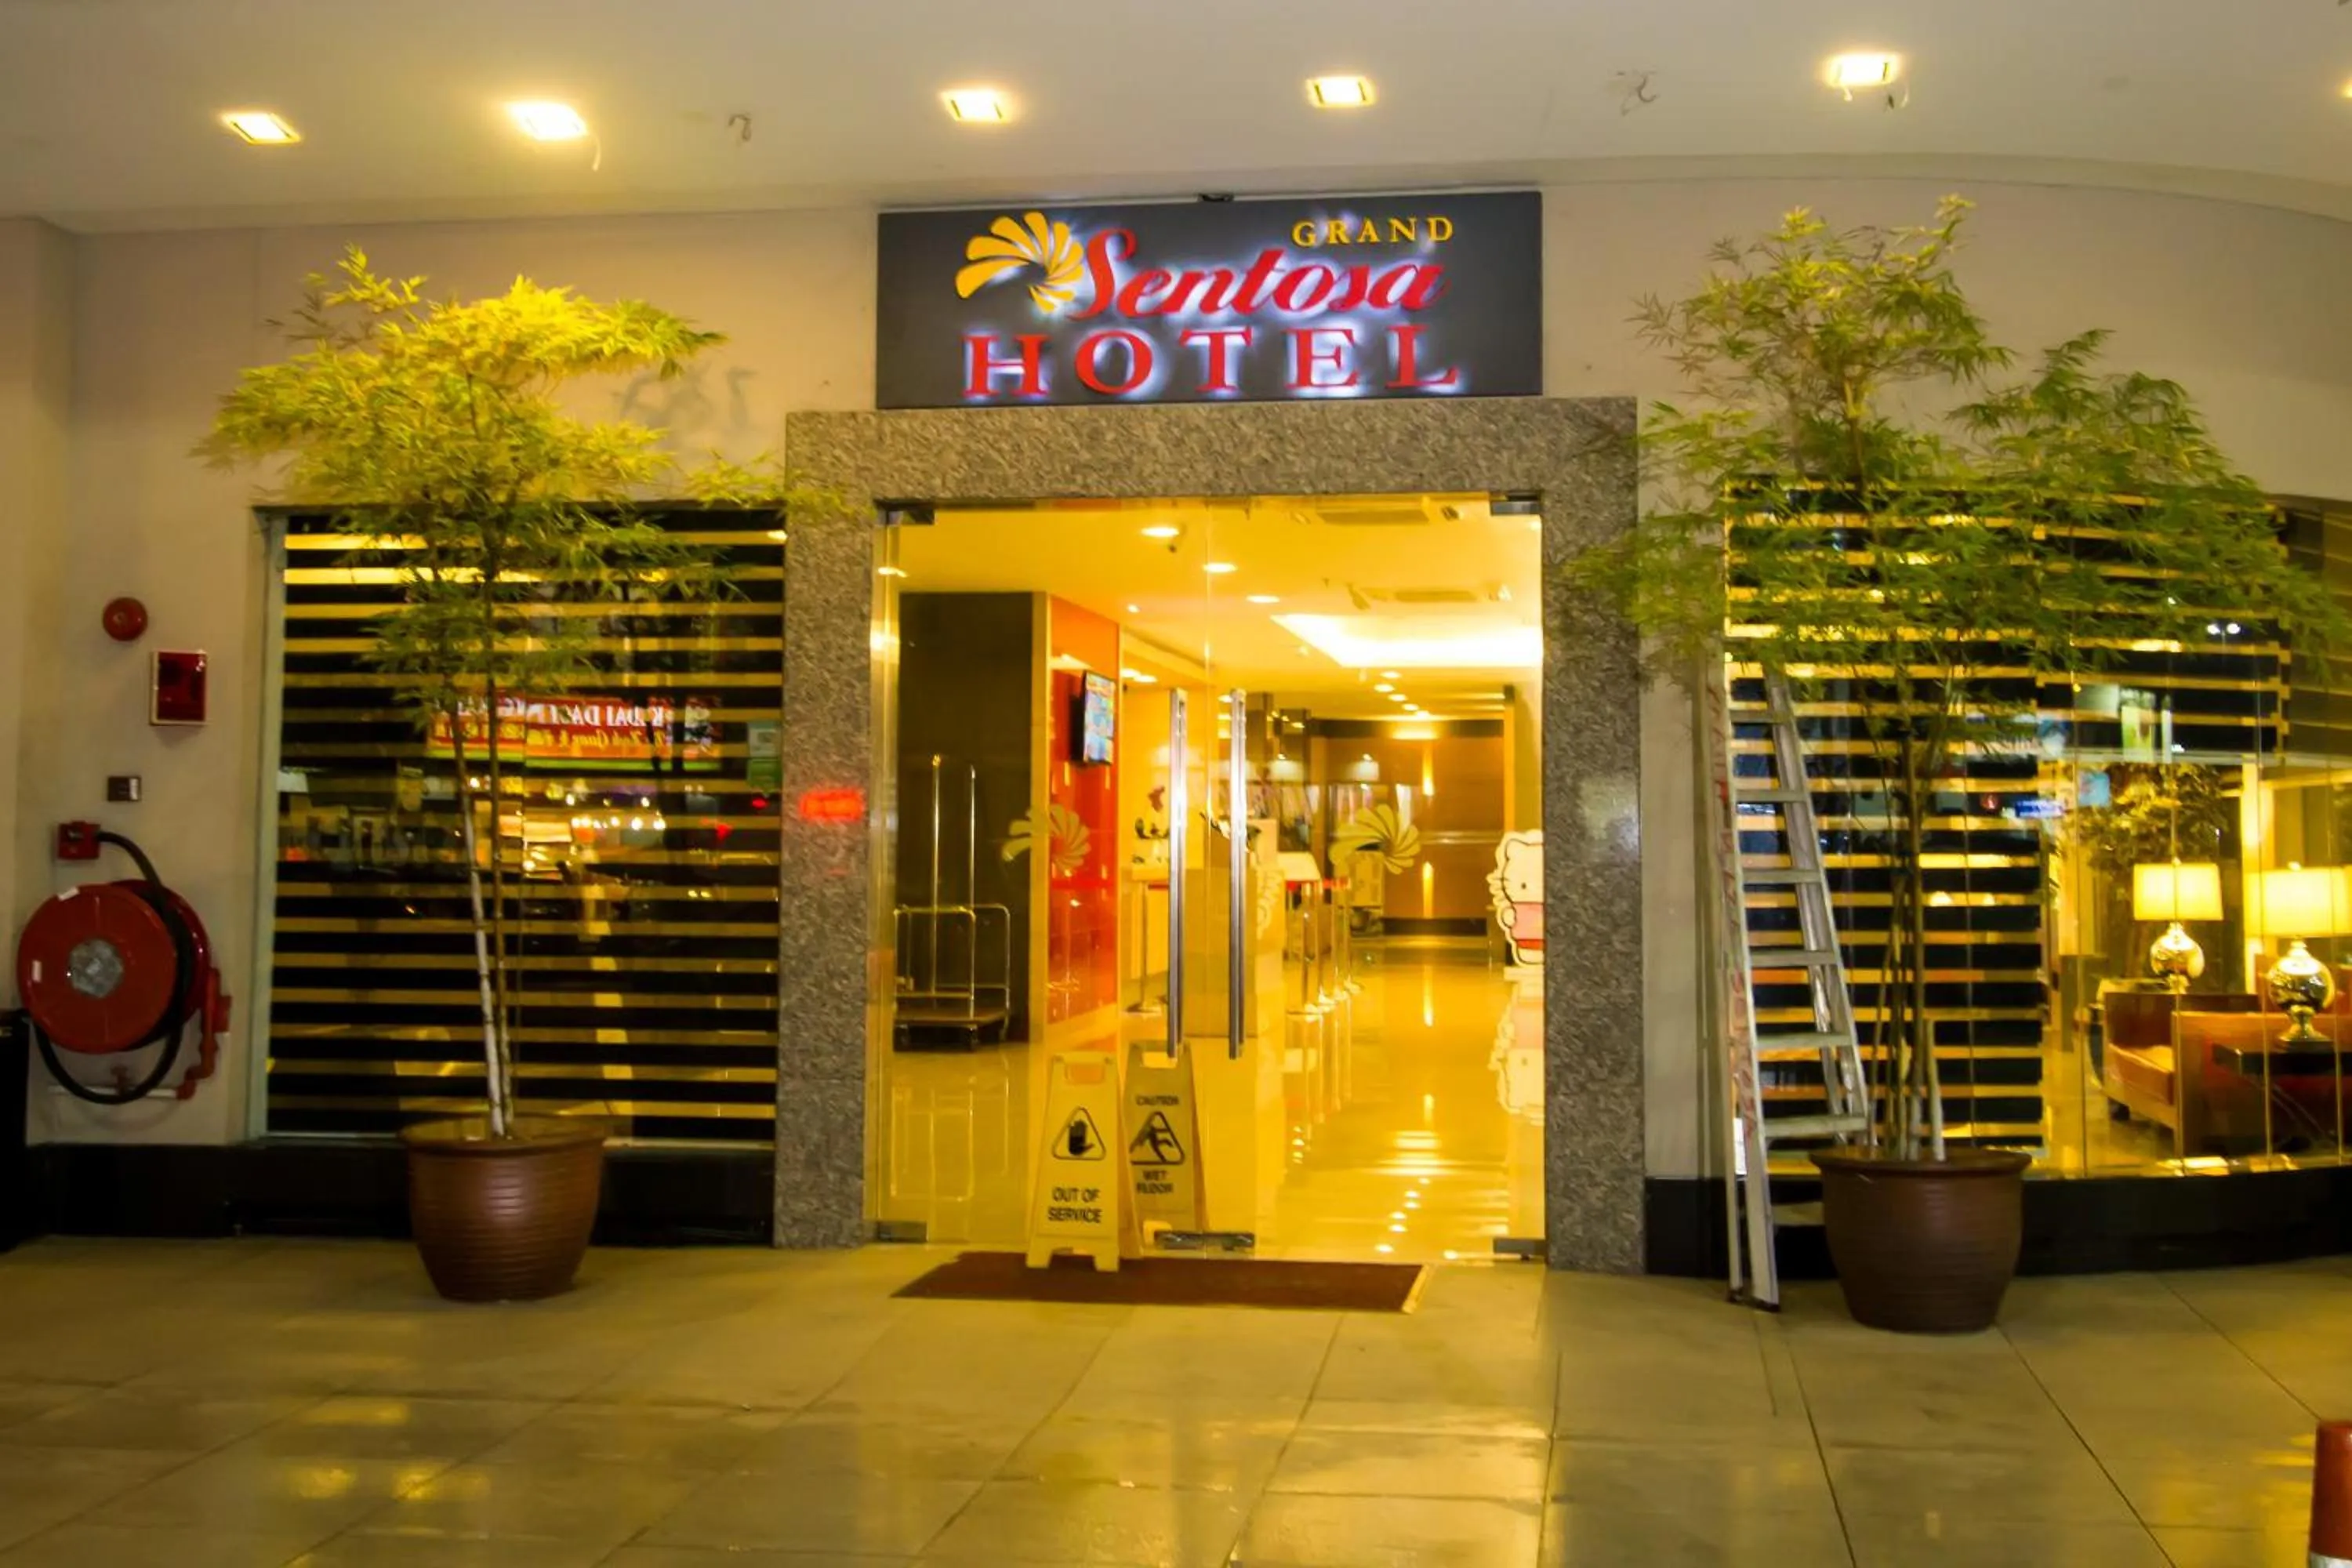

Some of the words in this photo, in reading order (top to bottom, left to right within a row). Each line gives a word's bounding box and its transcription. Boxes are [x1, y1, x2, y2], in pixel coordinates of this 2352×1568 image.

[1292, 216, 1454, 248] GRAND
[1070, 228, 1444, 319] Sentosa
[964, 324, 1458, 395] HOTEL
[1142, 1170, 1167, 1181] WET
[1052, 1186, 1079, 1203] OUT
[1082, 1187, 1101, 1203] OF
[1047, 1206, 1102, 1224] SERVICE
